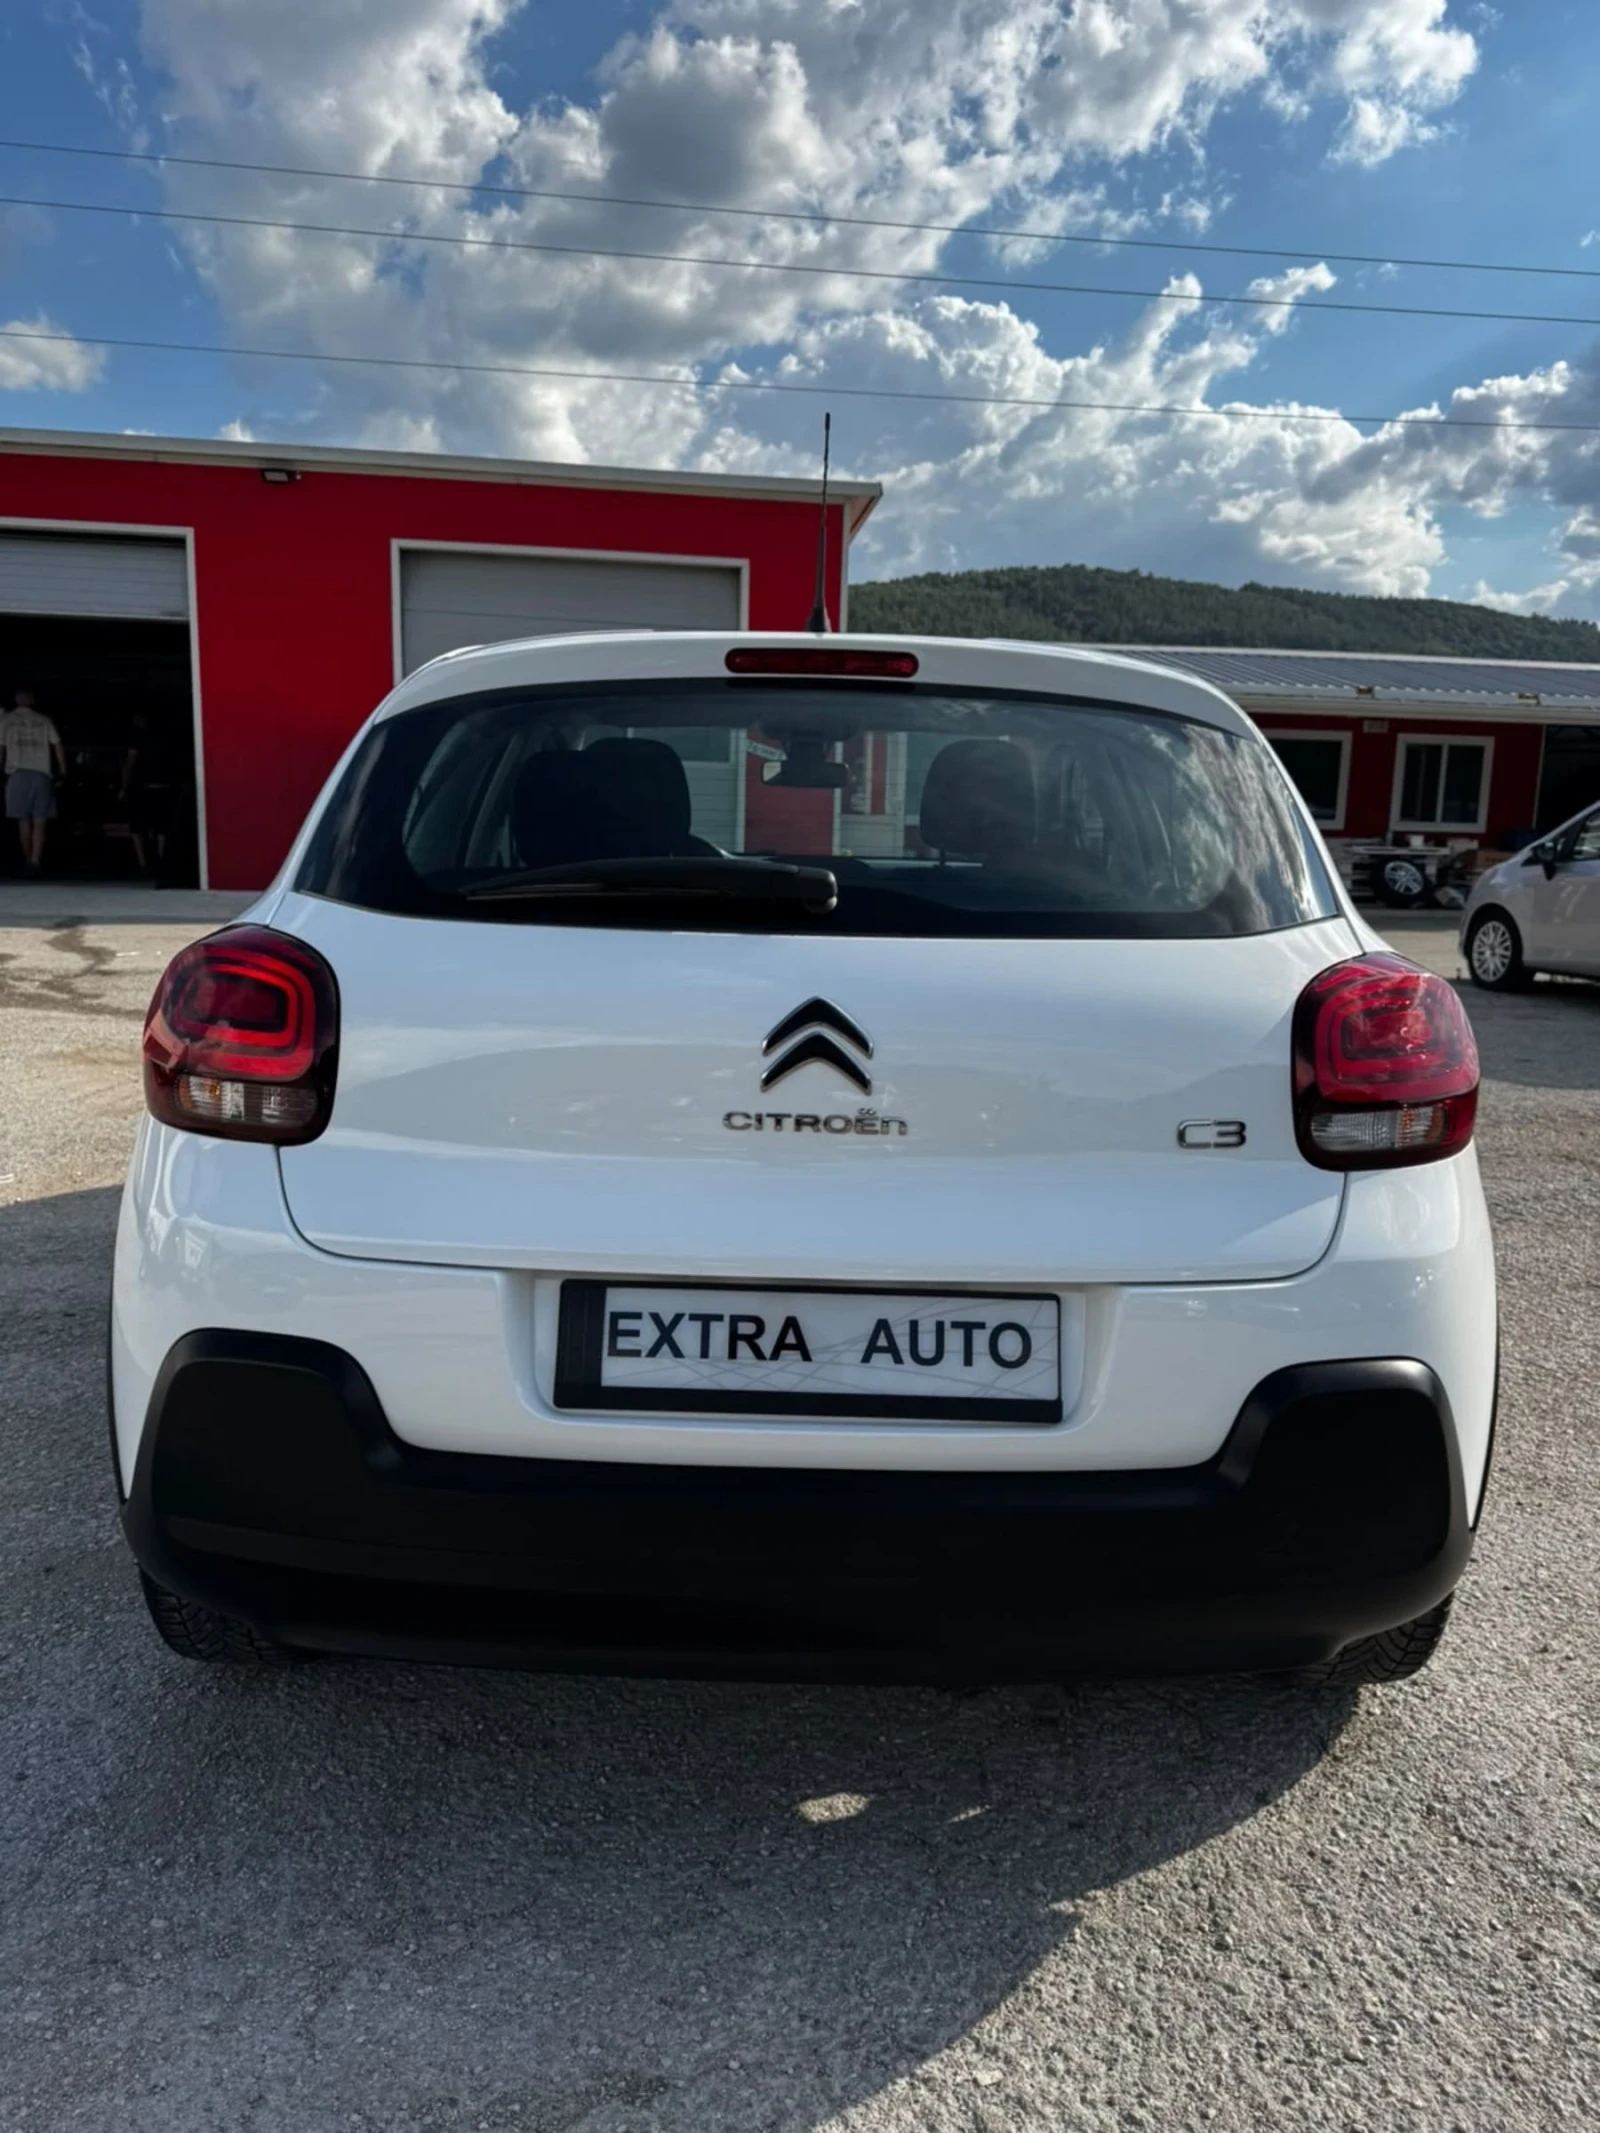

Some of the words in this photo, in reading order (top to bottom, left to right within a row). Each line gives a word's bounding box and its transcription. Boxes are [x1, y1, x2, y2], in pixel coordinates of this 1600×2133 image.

[1177, 1119, 1247, 1149] C3
[606, 1310, 813, 1362] EXTRA
[860, 1318, 1033, 1369] AUTO
